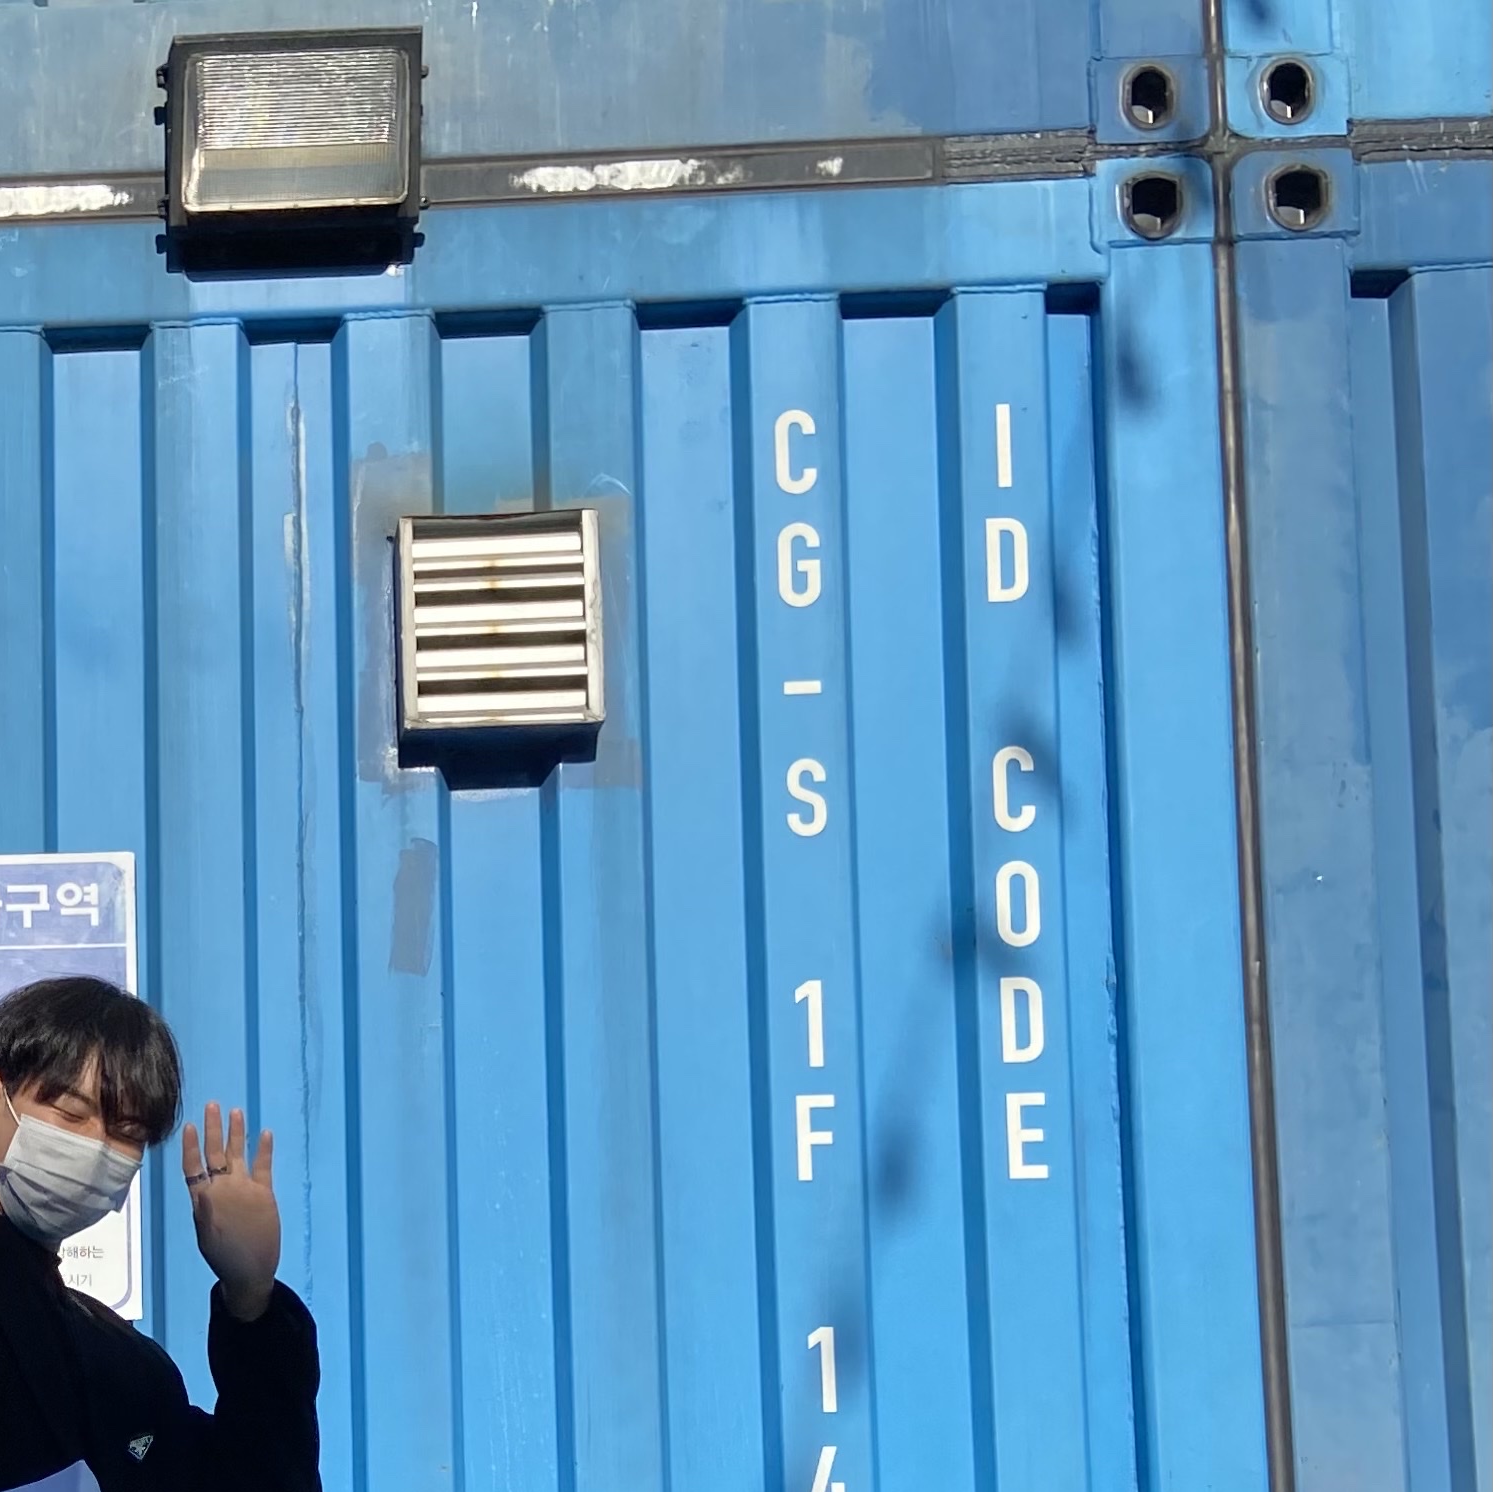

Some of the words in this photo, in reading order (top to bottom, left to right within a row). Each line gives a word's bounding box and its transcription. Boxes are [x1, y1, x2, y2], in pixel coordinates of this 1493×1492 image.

[985, 403, 1030, 603] ID
[991, 745, 1050, 1181] CODE
[794, 979, 836, 1182] 1F
